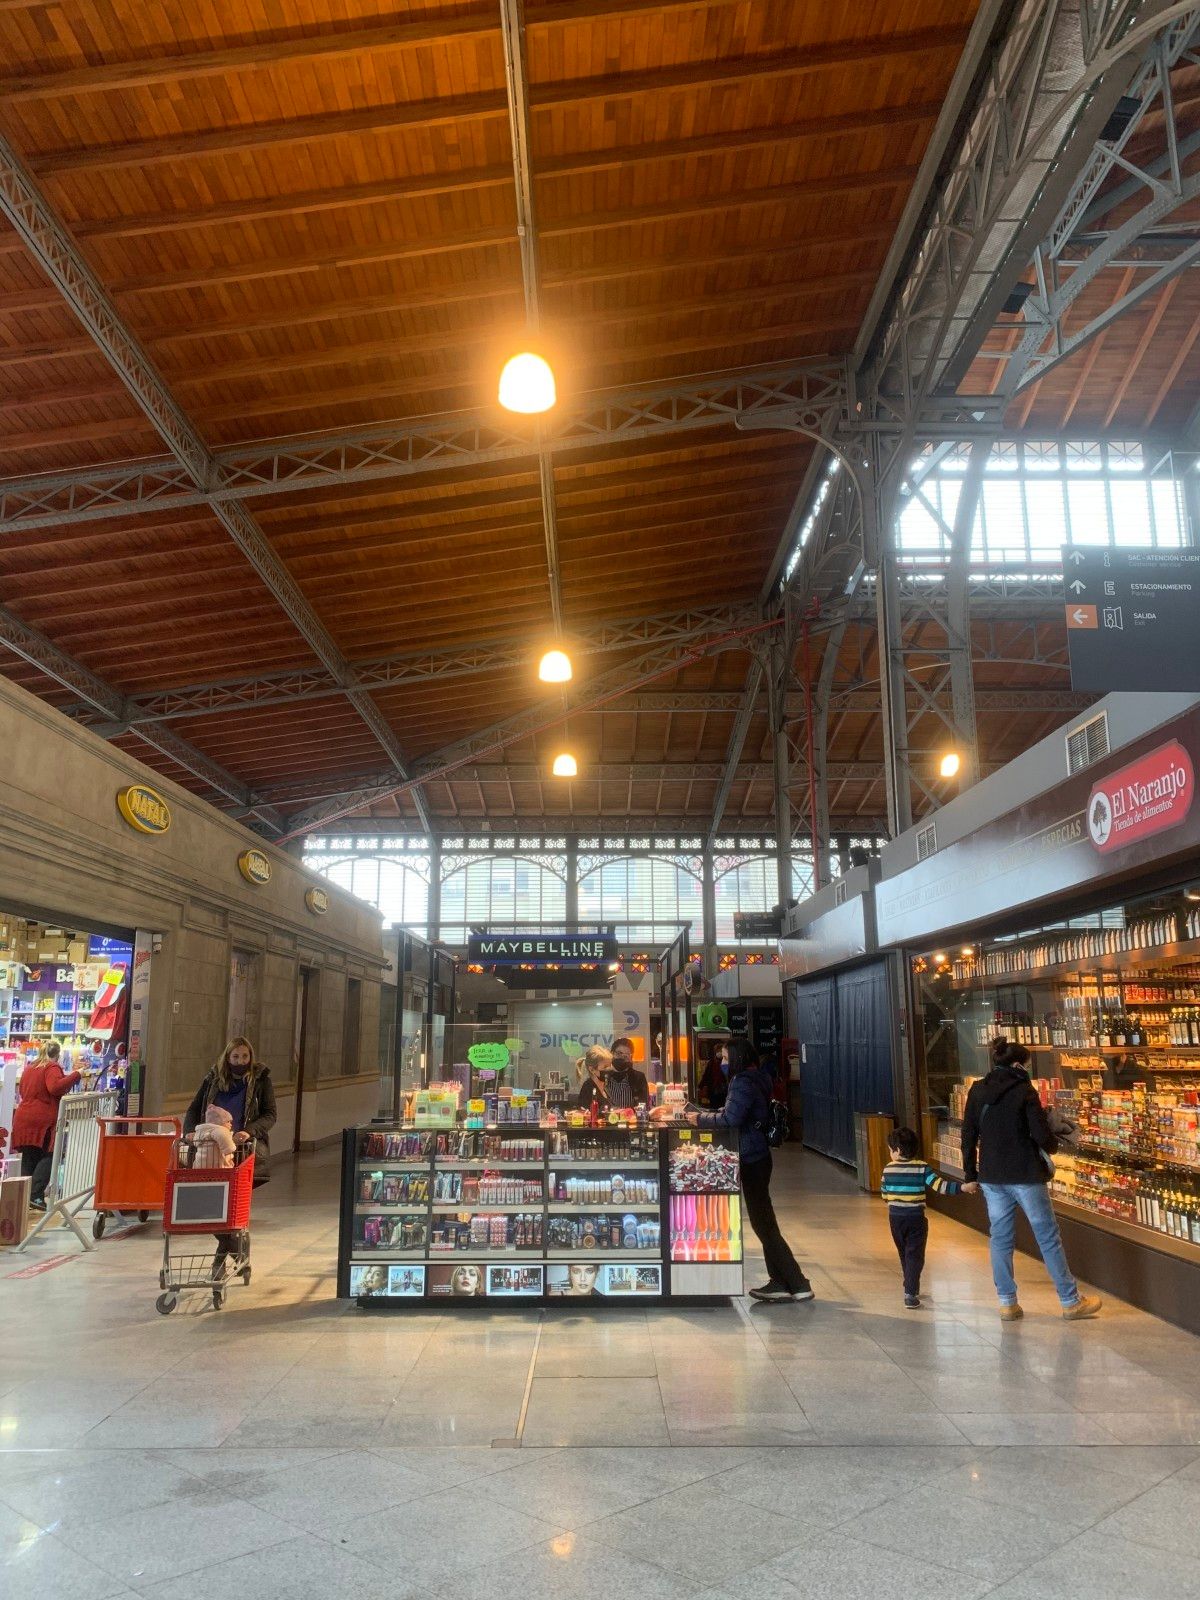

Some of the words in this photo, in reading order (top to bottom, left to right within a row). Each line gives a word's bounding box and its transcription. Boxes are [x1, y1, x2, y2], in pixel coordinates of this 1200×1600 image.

[1111, 788, 1126, 818] El
[1127, 762, 1186, 811] Naranjo
[1113, 815, 1134, 832] Tienda
[1134, 811, 1142, 822] de
[1142, 798, 1173, 820] alimentos
[480, 942, 604, 953] MAYBELLINE
